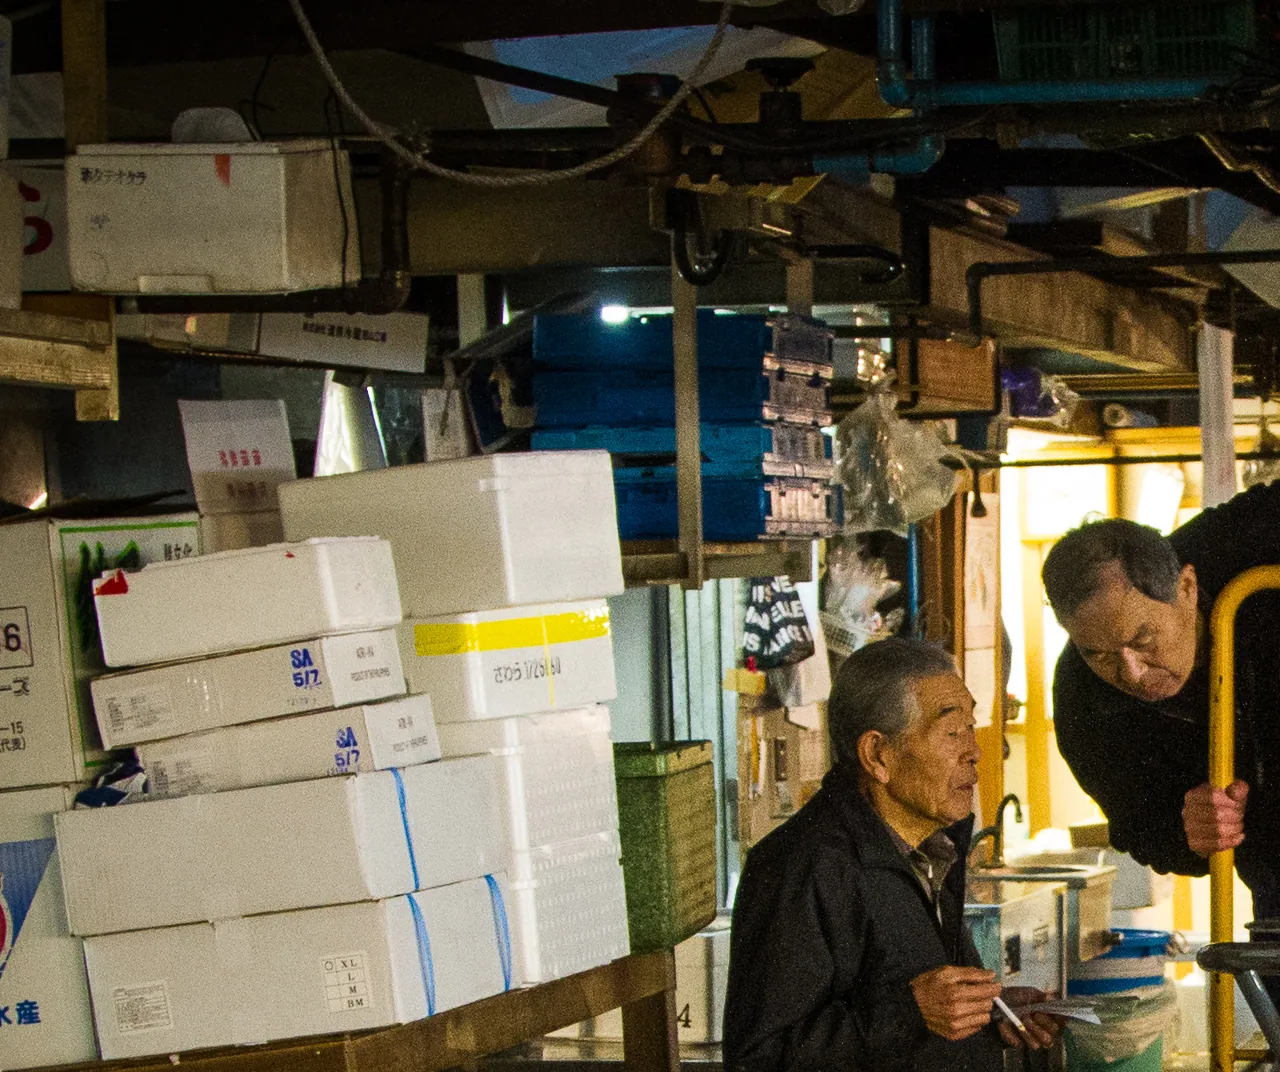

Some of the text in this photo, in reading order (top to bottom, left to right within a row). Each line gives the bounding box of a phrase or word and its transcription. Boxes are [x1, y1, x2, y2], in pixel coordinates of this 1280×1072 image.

[4, 623, 21, 651] 6
[290, 648, 313, 669] SA
[292, 669, 320, 687] 5/7
[336, 727, 358, 749] SA
[334, 749, 360, 767] 5/7
[341, 959, 357, 968] XL
[348, 972, 355, 981] L
[349, 985, 357, 994] M
[347, 998, 364, 1008] BM
[677, 1003, 692, 1028] 4
